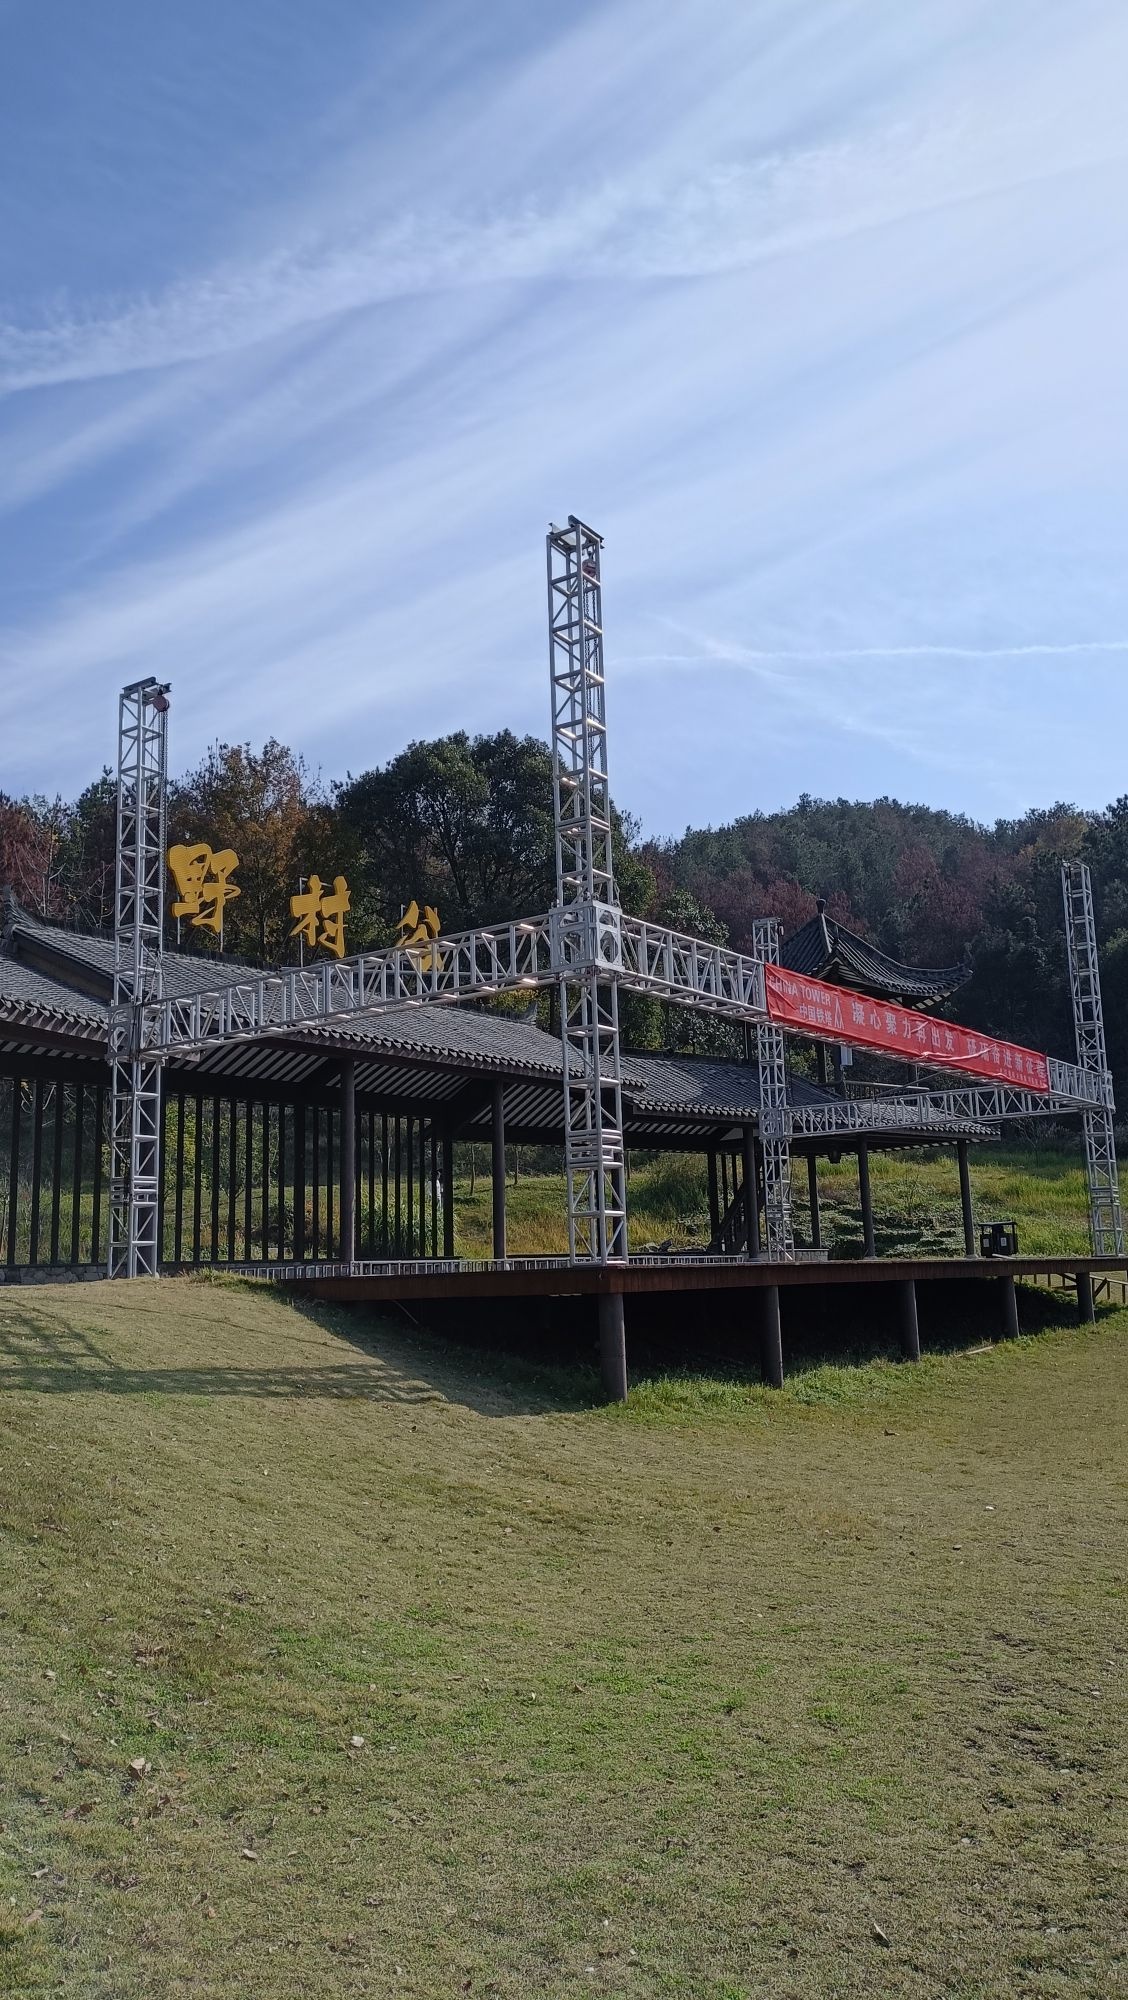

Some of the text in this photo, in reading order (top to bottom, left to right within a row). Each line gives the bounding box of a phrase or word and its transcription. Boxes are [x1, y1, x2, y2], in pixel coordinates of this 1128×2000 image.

[769, 975, 831, 1007] CHINA TOWER
[799, 1003, 832, 1026] 中国铁塔
